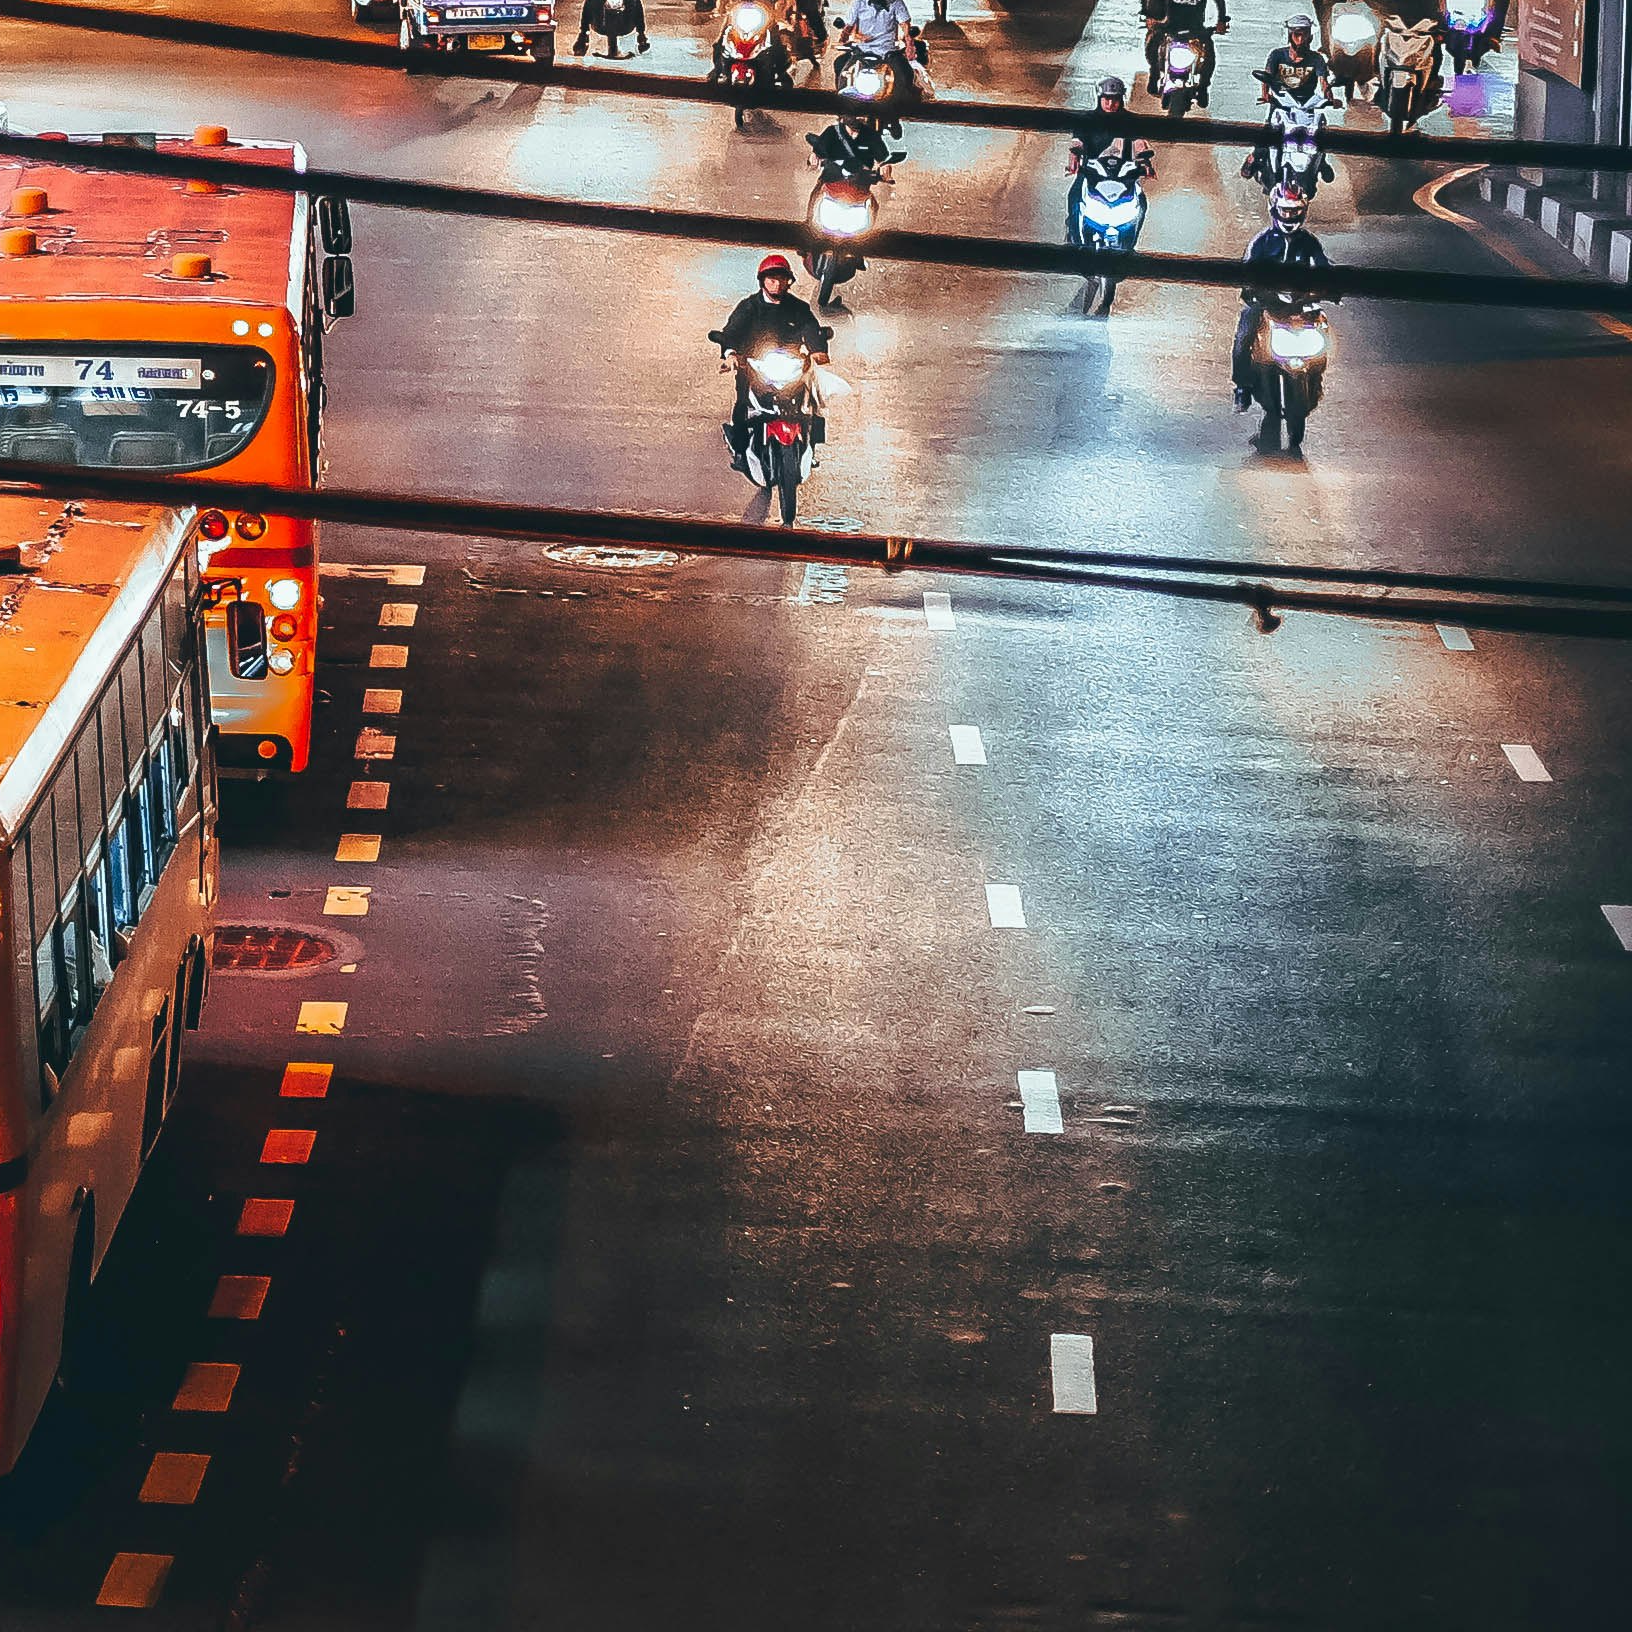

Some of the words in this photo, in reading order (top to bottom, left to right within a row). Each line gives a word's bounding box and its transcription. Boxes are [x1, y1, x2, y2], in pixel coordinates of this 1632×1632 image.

[451, 7, 524, 17] THAILAND
[74, 360, 115, 380] 74
[175, 399, 241, 419] 74-5
